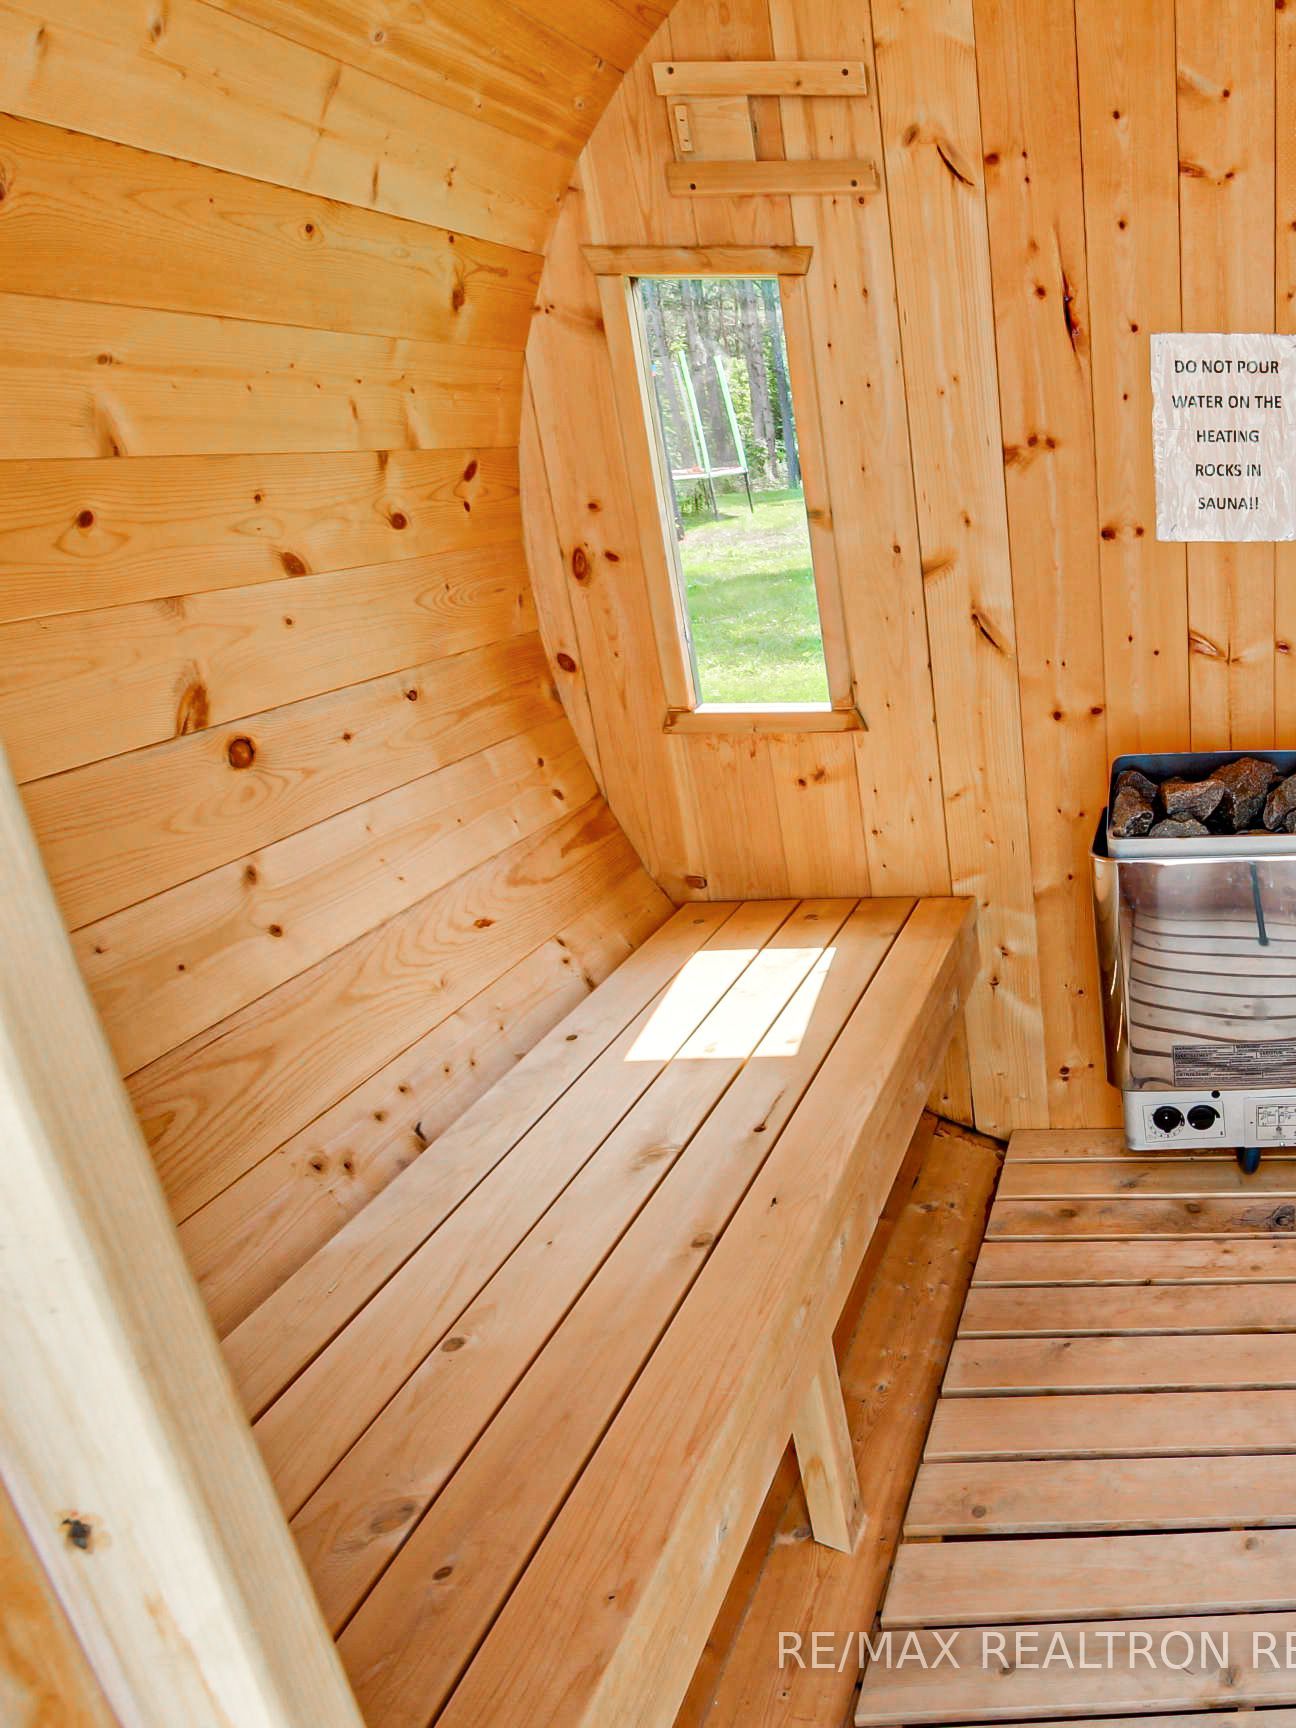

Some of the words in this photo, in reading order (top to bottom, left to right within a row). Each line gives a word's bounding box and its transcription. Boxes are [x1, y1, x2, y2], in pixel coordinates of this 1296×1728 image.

[1174, 360, 1197, 374] DO
[1202, 360, 1232, 374] NOT
[1237, 360, 1279, 374] POUR
[1172, 395, 1223, 409] WATER
[1228, 395, 1250, 409] ON
[1255, 395, 1282, 409] THE
[1196, 430, 1260, 443] HEATING
[1195, 464, 1242, 477] ROCKS
[1246, 464, 1262, 477] IN
[1197, 497, 1259, 510] SAUNA!!
